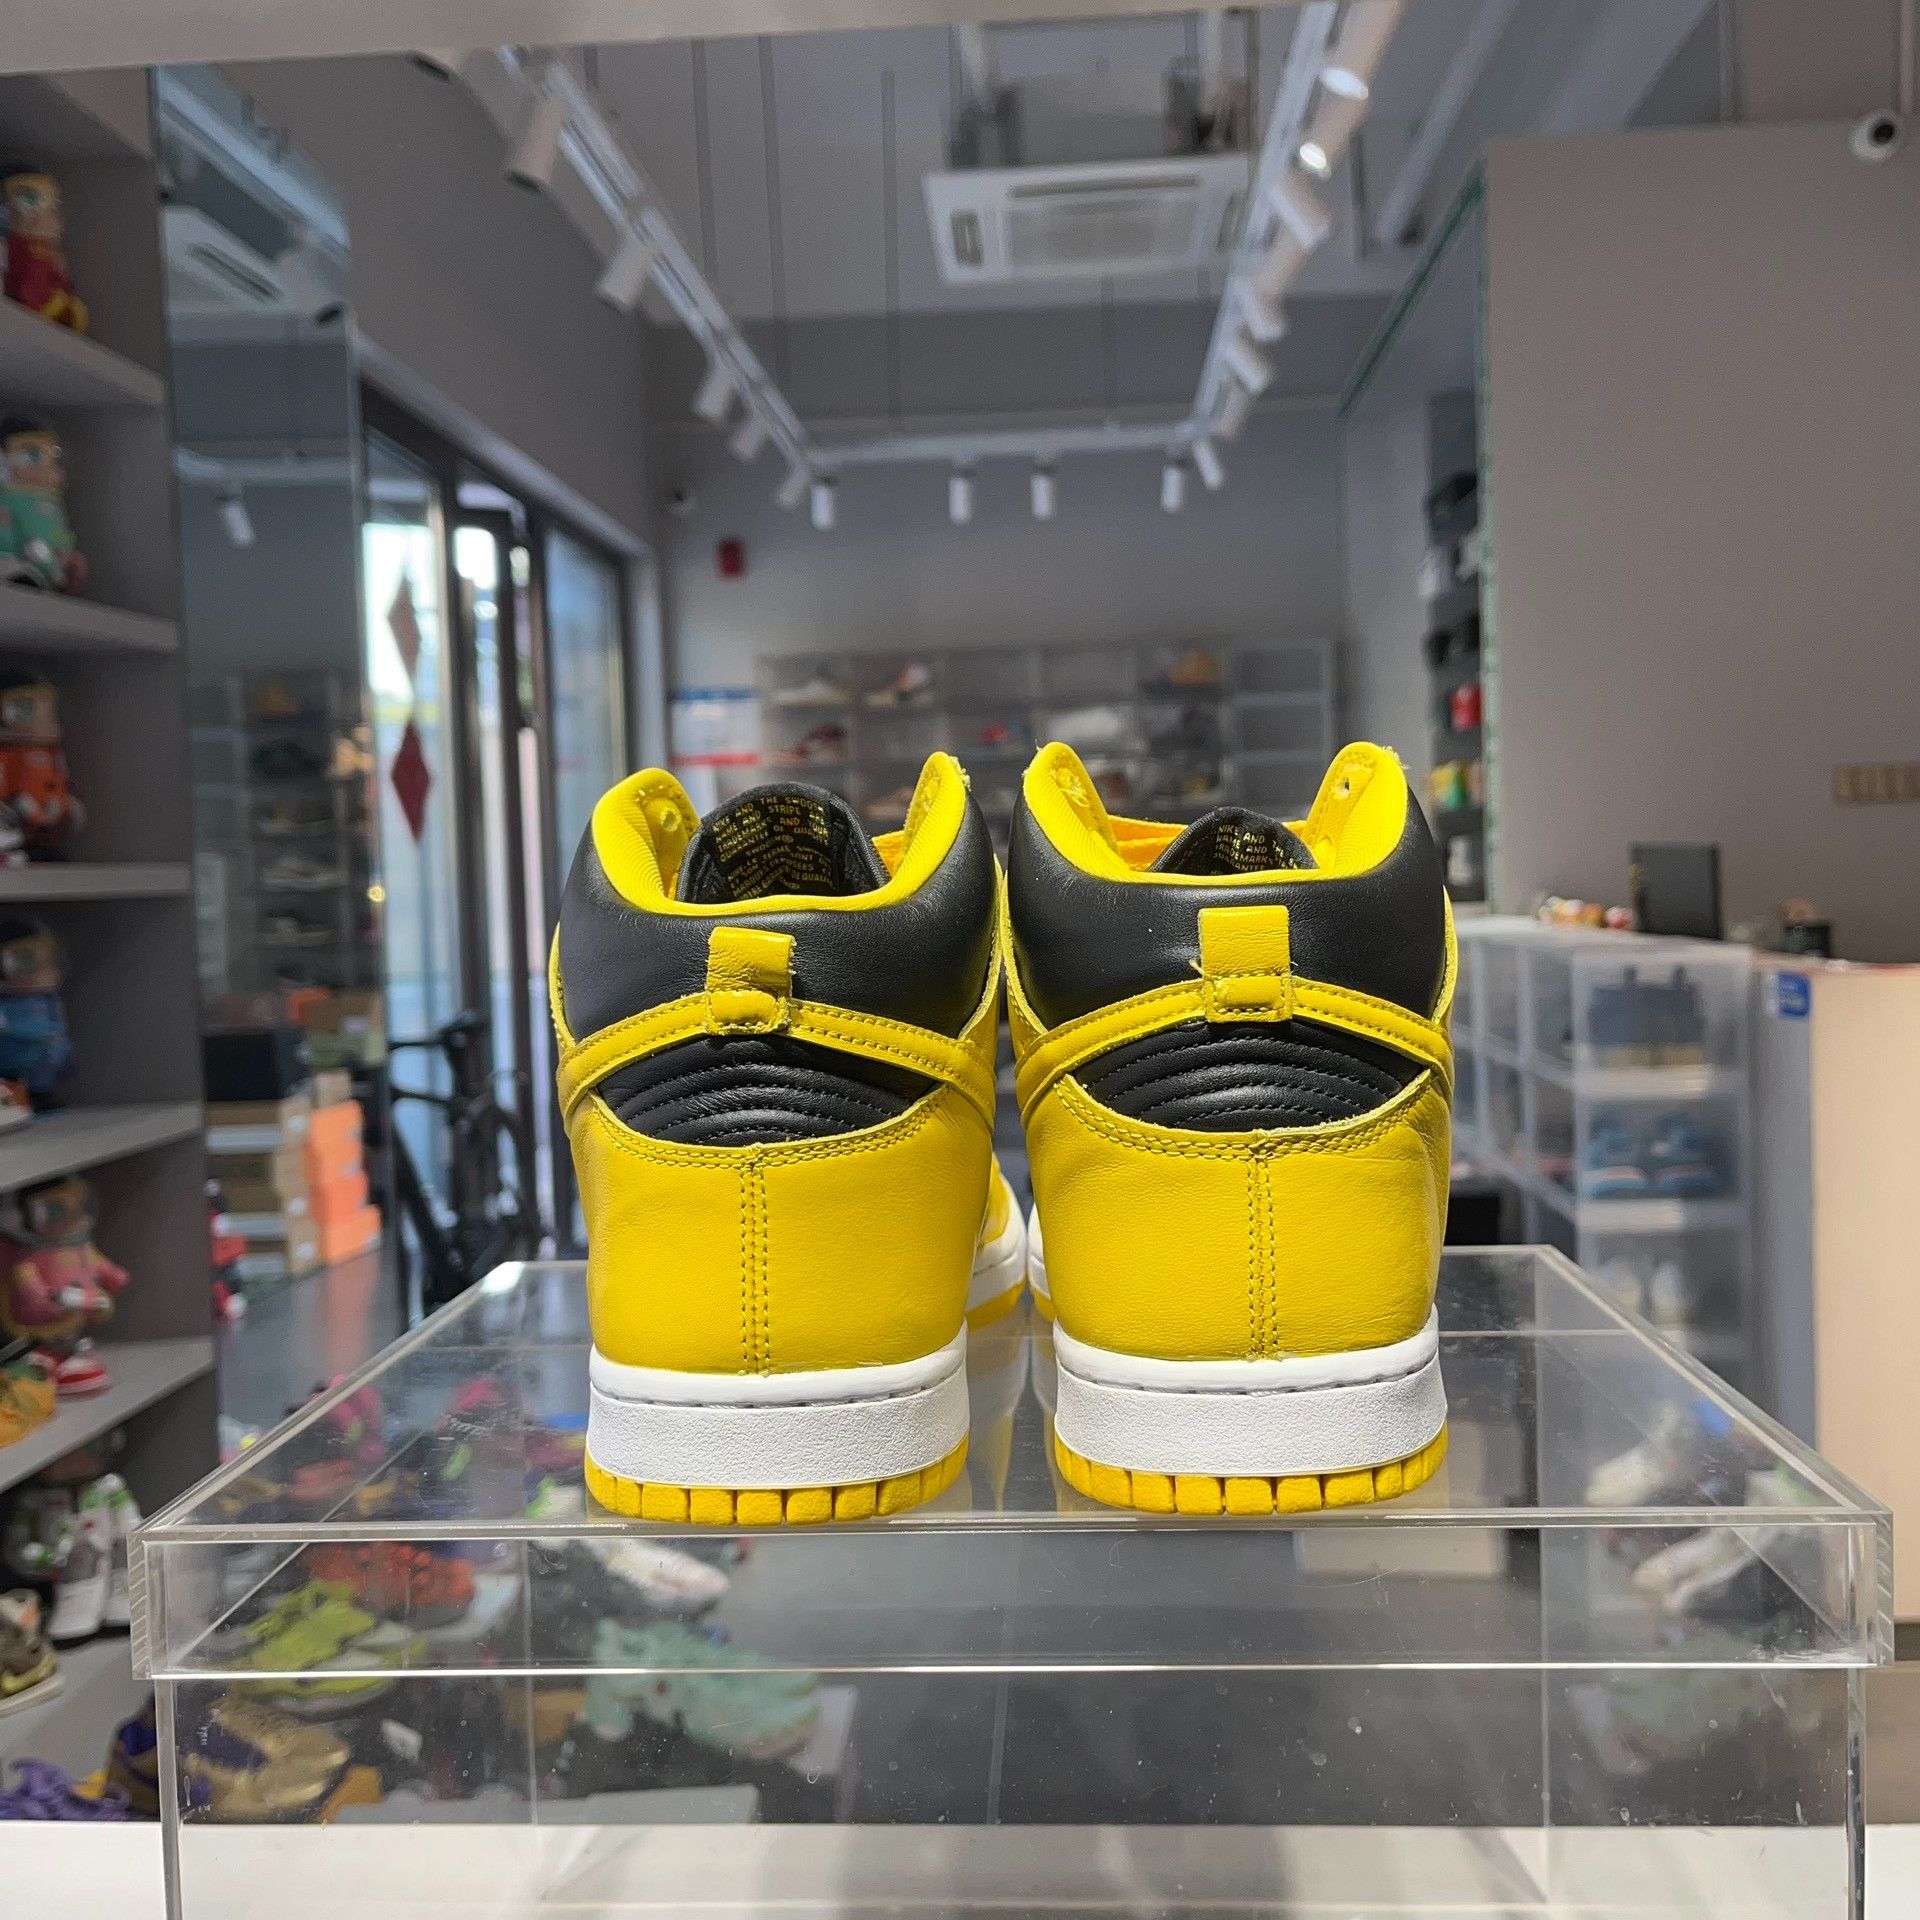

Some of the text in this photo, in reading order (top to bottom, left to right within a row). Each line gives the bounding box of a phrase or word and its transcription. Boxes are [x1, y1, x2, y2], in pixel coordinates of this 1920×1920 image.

[735, 802, 754, 817] AND
[761, 796, 777, 804] THE
[768, 805, 801, 815] STRIPE
[1218, 824, 1239, 836] NIKE
[1243, 832, 1265, 844] AND
[1216, 835, 1241, 849] NAME
[1245, 845, 1268, 854] AND
